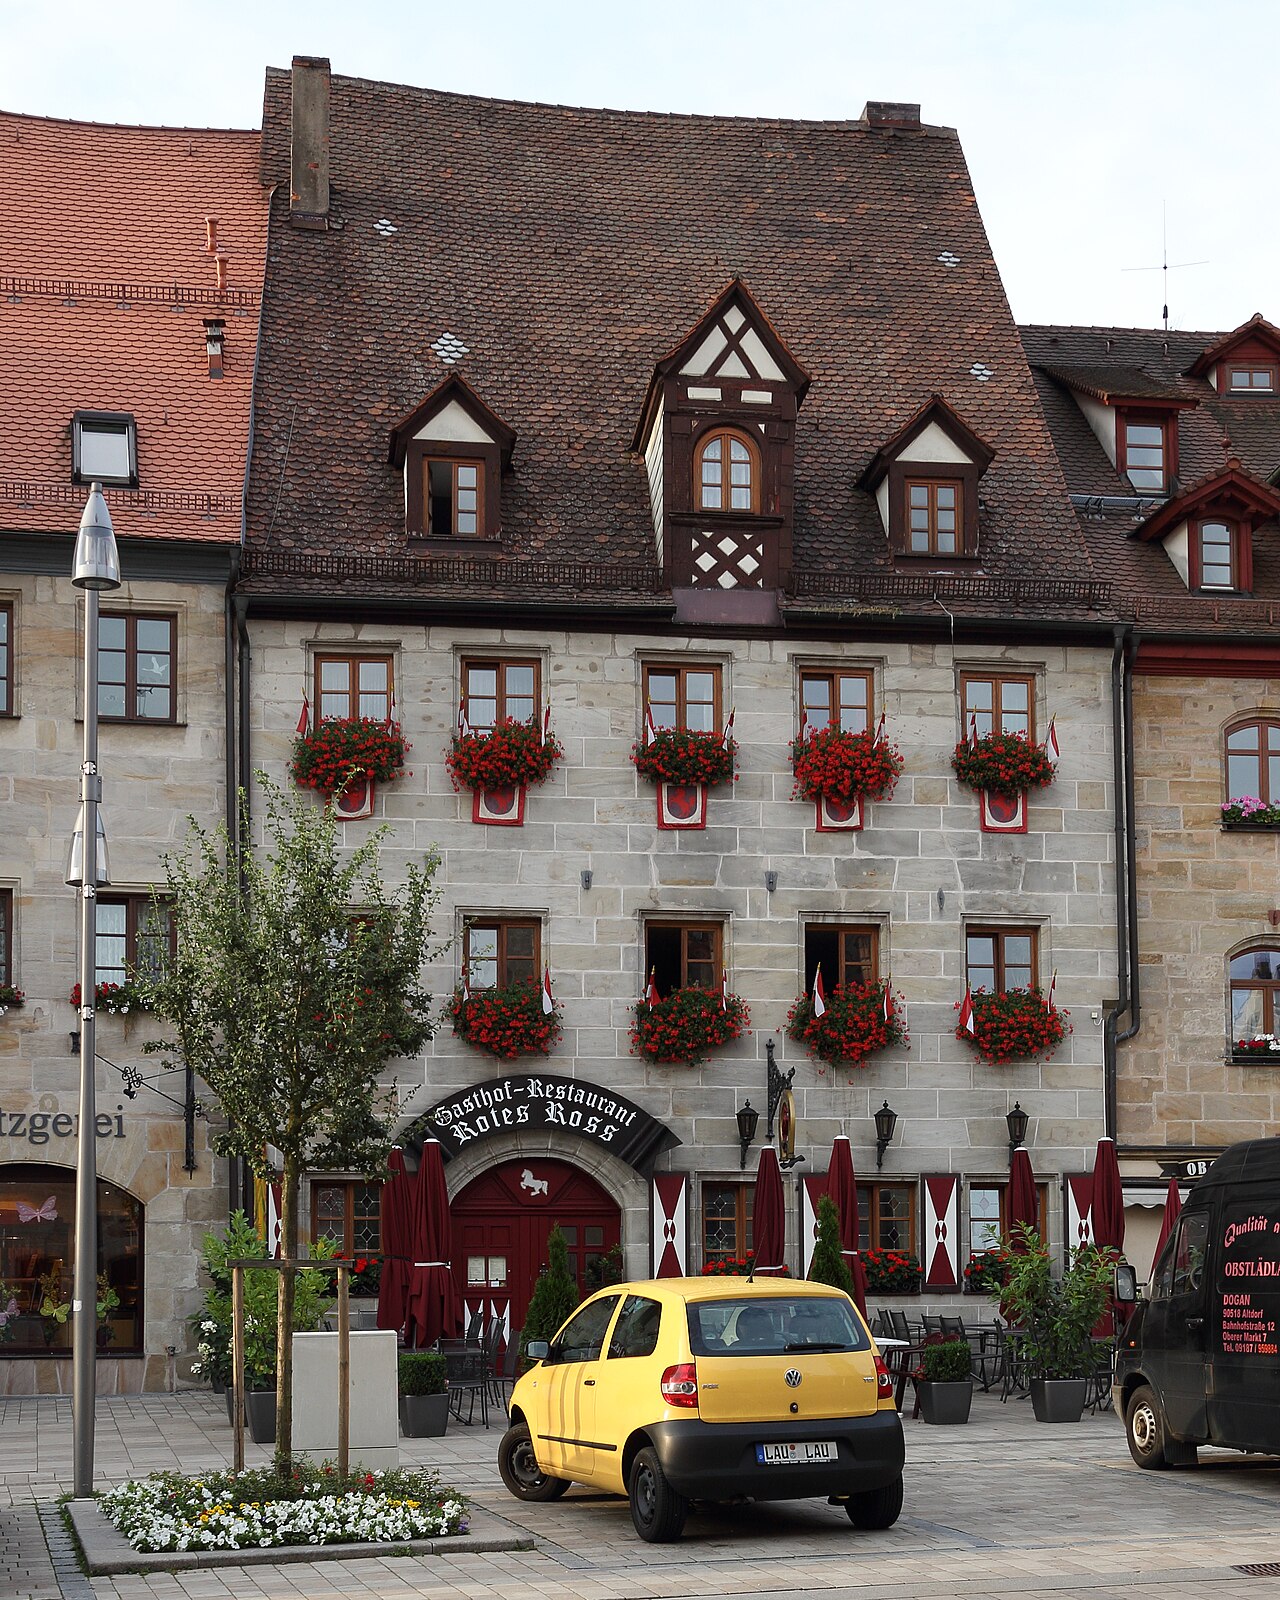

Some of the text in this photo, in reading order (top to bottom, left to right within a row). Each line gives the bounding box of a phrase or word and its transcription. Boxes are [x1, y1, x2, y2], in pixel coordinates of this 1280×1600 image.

[434, 1078, 637, 1127] Gasthof-Restaurant
[449, 1101, 620, 1146] Rotes Ross
[1186, 1161, 1215, 1176] OB
[1224, 1215, 1268, 1248] Qualität
[1223, 1294, 1250, 1306] DOGAN
[1222, 1308, 1264, 1319] 90518 Altdorf
[1222, 1320, 1275, 1331] Bahnhofstraße 12
[1222, 1331, 1267, 1342] Oberer Markt 7
[1223, 1342, 1234, 1352] Tel.
[764, 1443, 830, 1460] LAU LAU
